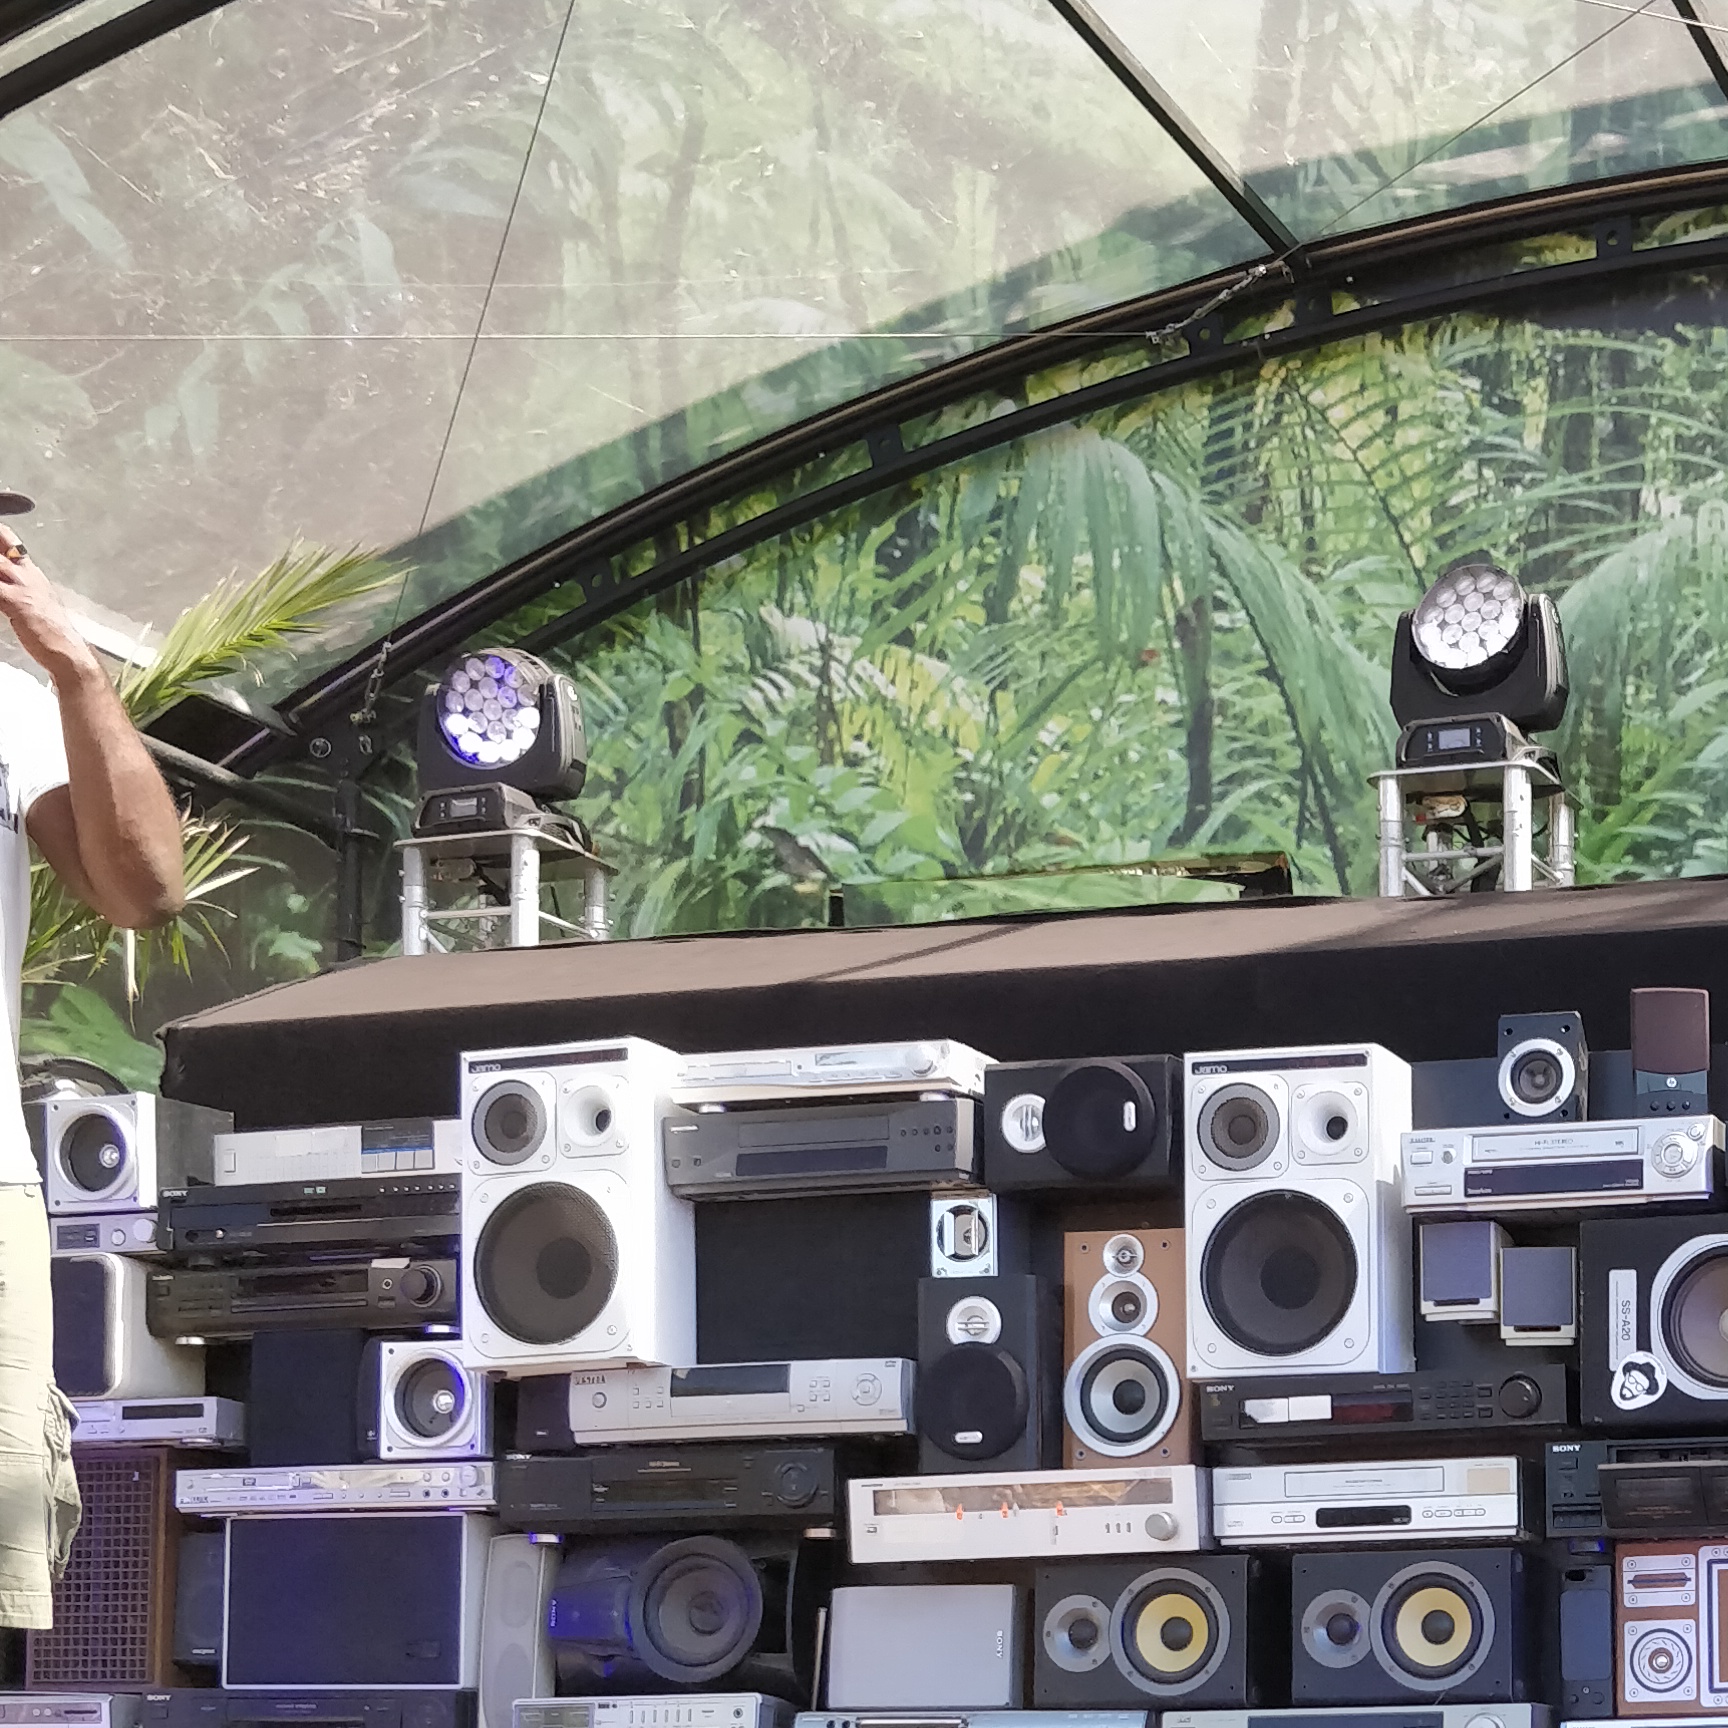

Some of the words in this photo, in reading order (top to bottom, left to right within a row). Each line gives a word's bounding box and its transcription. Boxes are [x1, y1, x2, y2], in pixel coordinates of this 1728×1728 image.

[471, 1063, 501, 1073] Jamo
[1194, 1065, 1228, 1074] Jamo
[163, 1190, 188, 1198] SONY
[1621, 1299, 1631, 1341] SS-A20
[1206, 1385, 1235, 1393] SONY
[1552, 1444, 1581, 1452] SONY
[996, 1630, 1004, 1659] SONY
